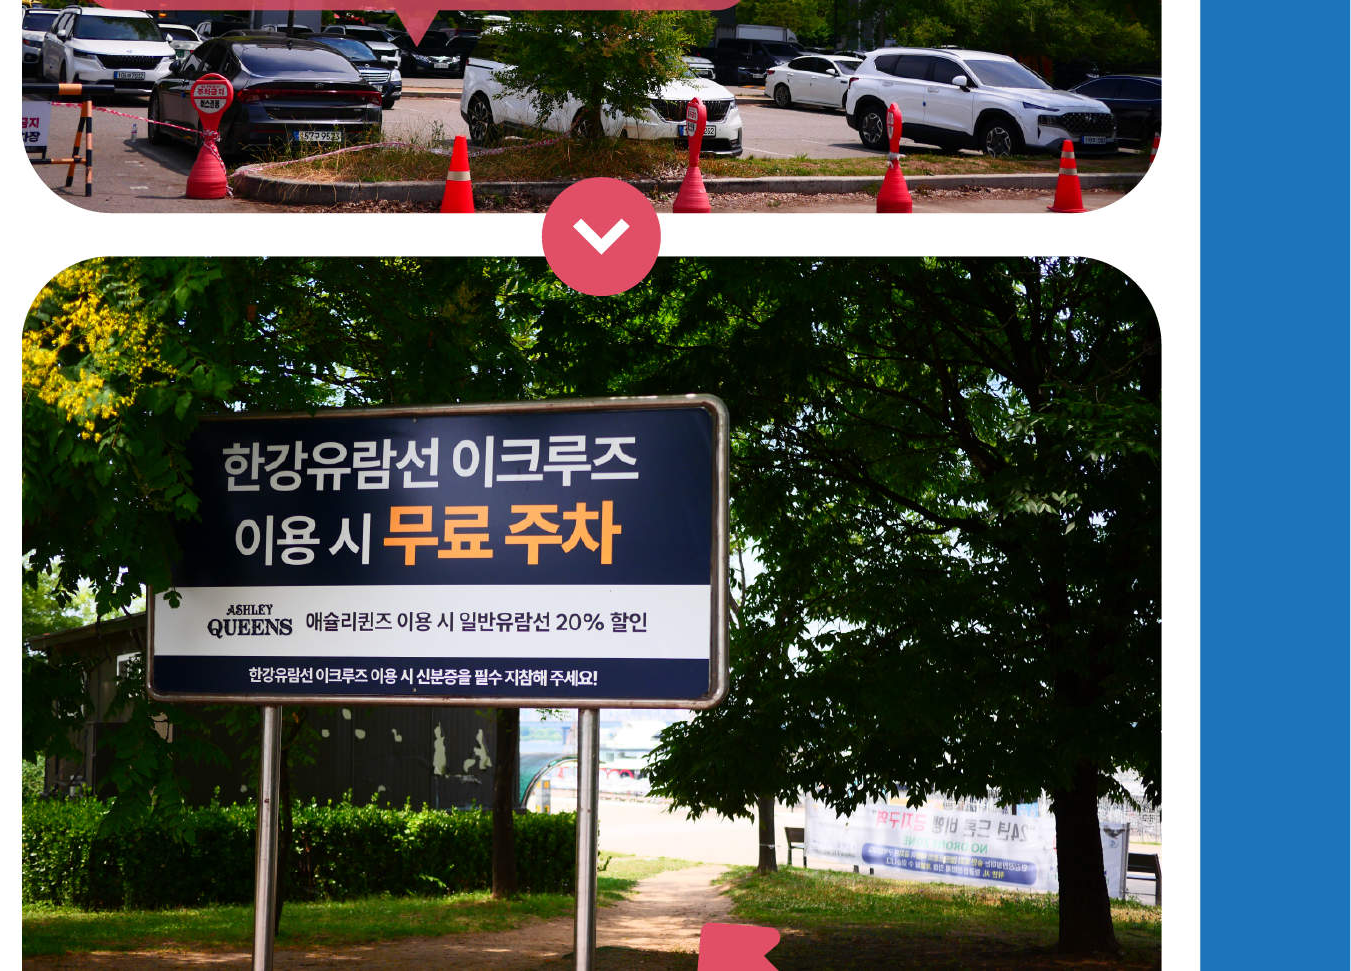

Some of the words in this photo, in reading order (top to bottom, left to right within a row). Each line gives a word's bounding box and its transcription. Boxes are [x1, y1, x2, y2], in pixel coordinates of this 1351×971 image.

[222, 437, 439, 492] 한강유람선
[452, 435, 639, 489] 이크루즈
[235, 513, 321, 566] 이용
[329, 513, 371, 565] 시
[383, 505, 493, 566] 무료
[504, 500, 622, 565] 주차
[226, 604, 273, 616] ASHLEY
[207, 618, 293, 638] QUEENS
[306, 611, 392, 632] 애슐리퀸즈
[397, 611, 432, 632] 이용
[437, 611, 454, 632] 시
[460, 611, 550, 632] 일반유람선
[555, 612, 605, 632] 20%
[610, 611, 647, 633] 할인
[249, 666, 313, 684] 한강유람선
[315, 667, 367, 684] 이크루즈
[371, 667, 397, 684] 이용
[400, 667, 414, 684] 시
[416, 667, 472, 685] 신분증을
[475, 668, 501, 685] 필수
[504, 668, 547, 686] 지참해
[550, 669, 597, 686] 주세요!
